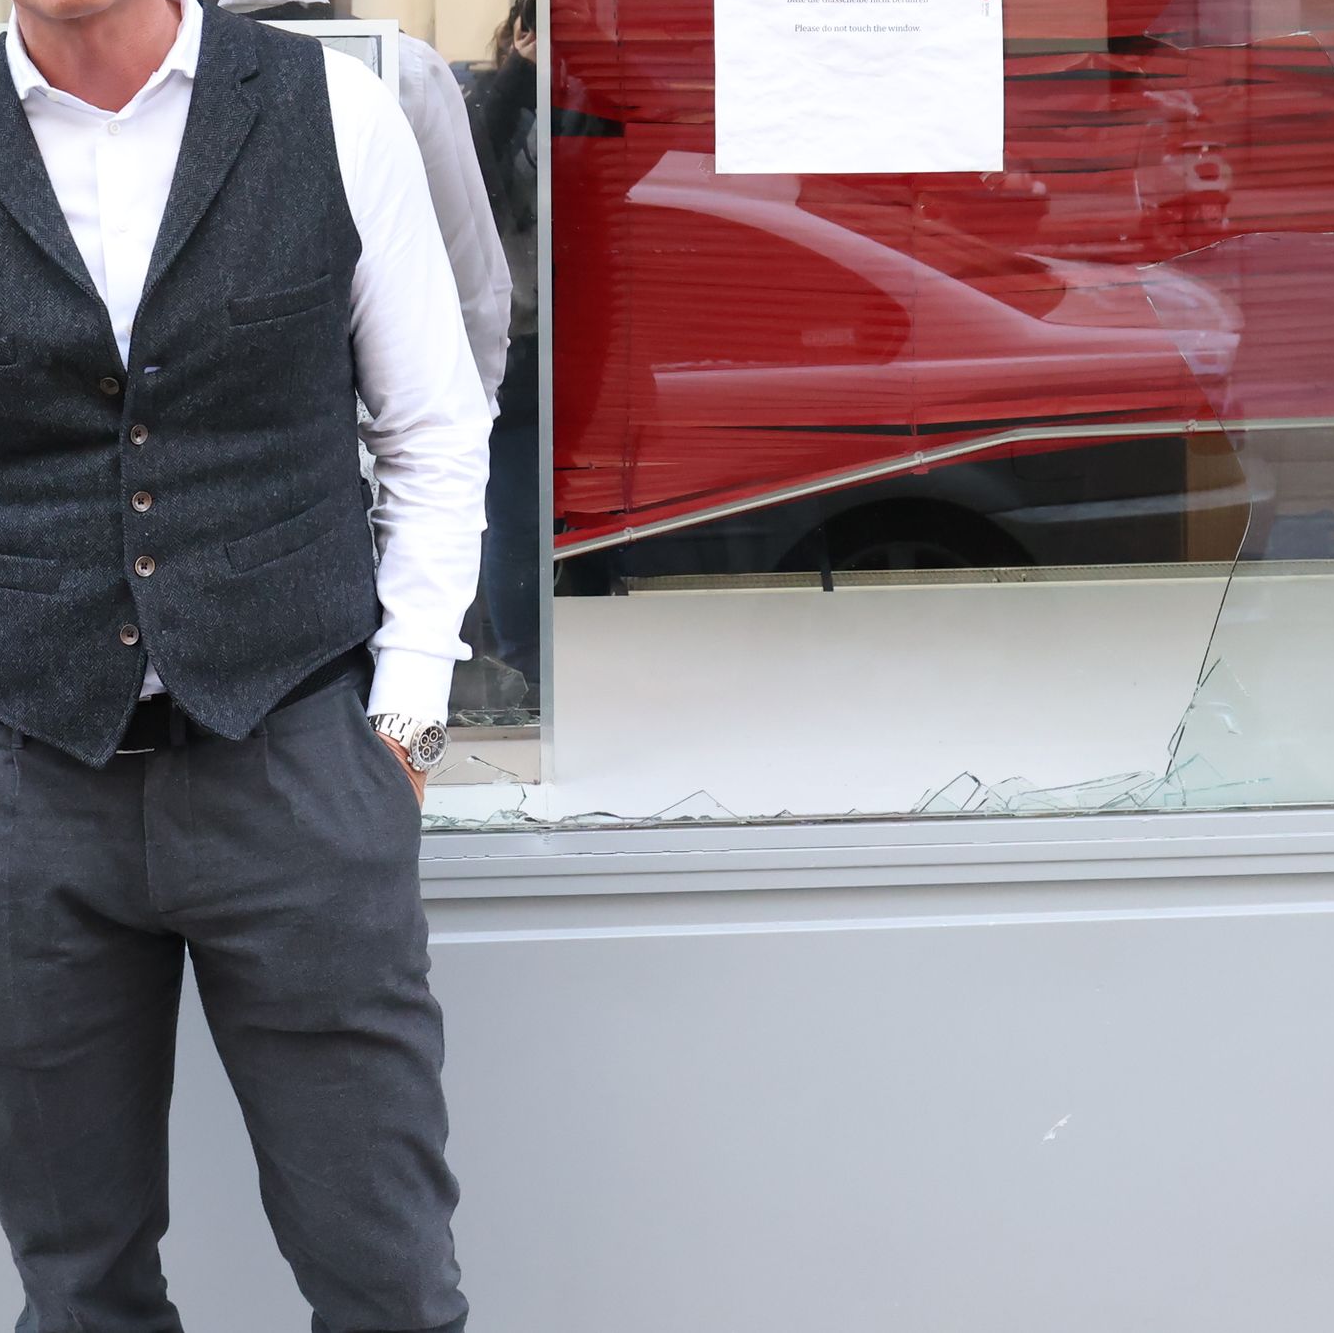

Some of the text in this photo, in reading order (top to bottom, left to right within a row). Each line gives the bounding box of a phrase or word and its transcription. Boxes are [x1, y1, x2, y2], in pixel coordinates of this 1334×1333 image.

[794, 23, 923, 33] Please do not touch the window.
